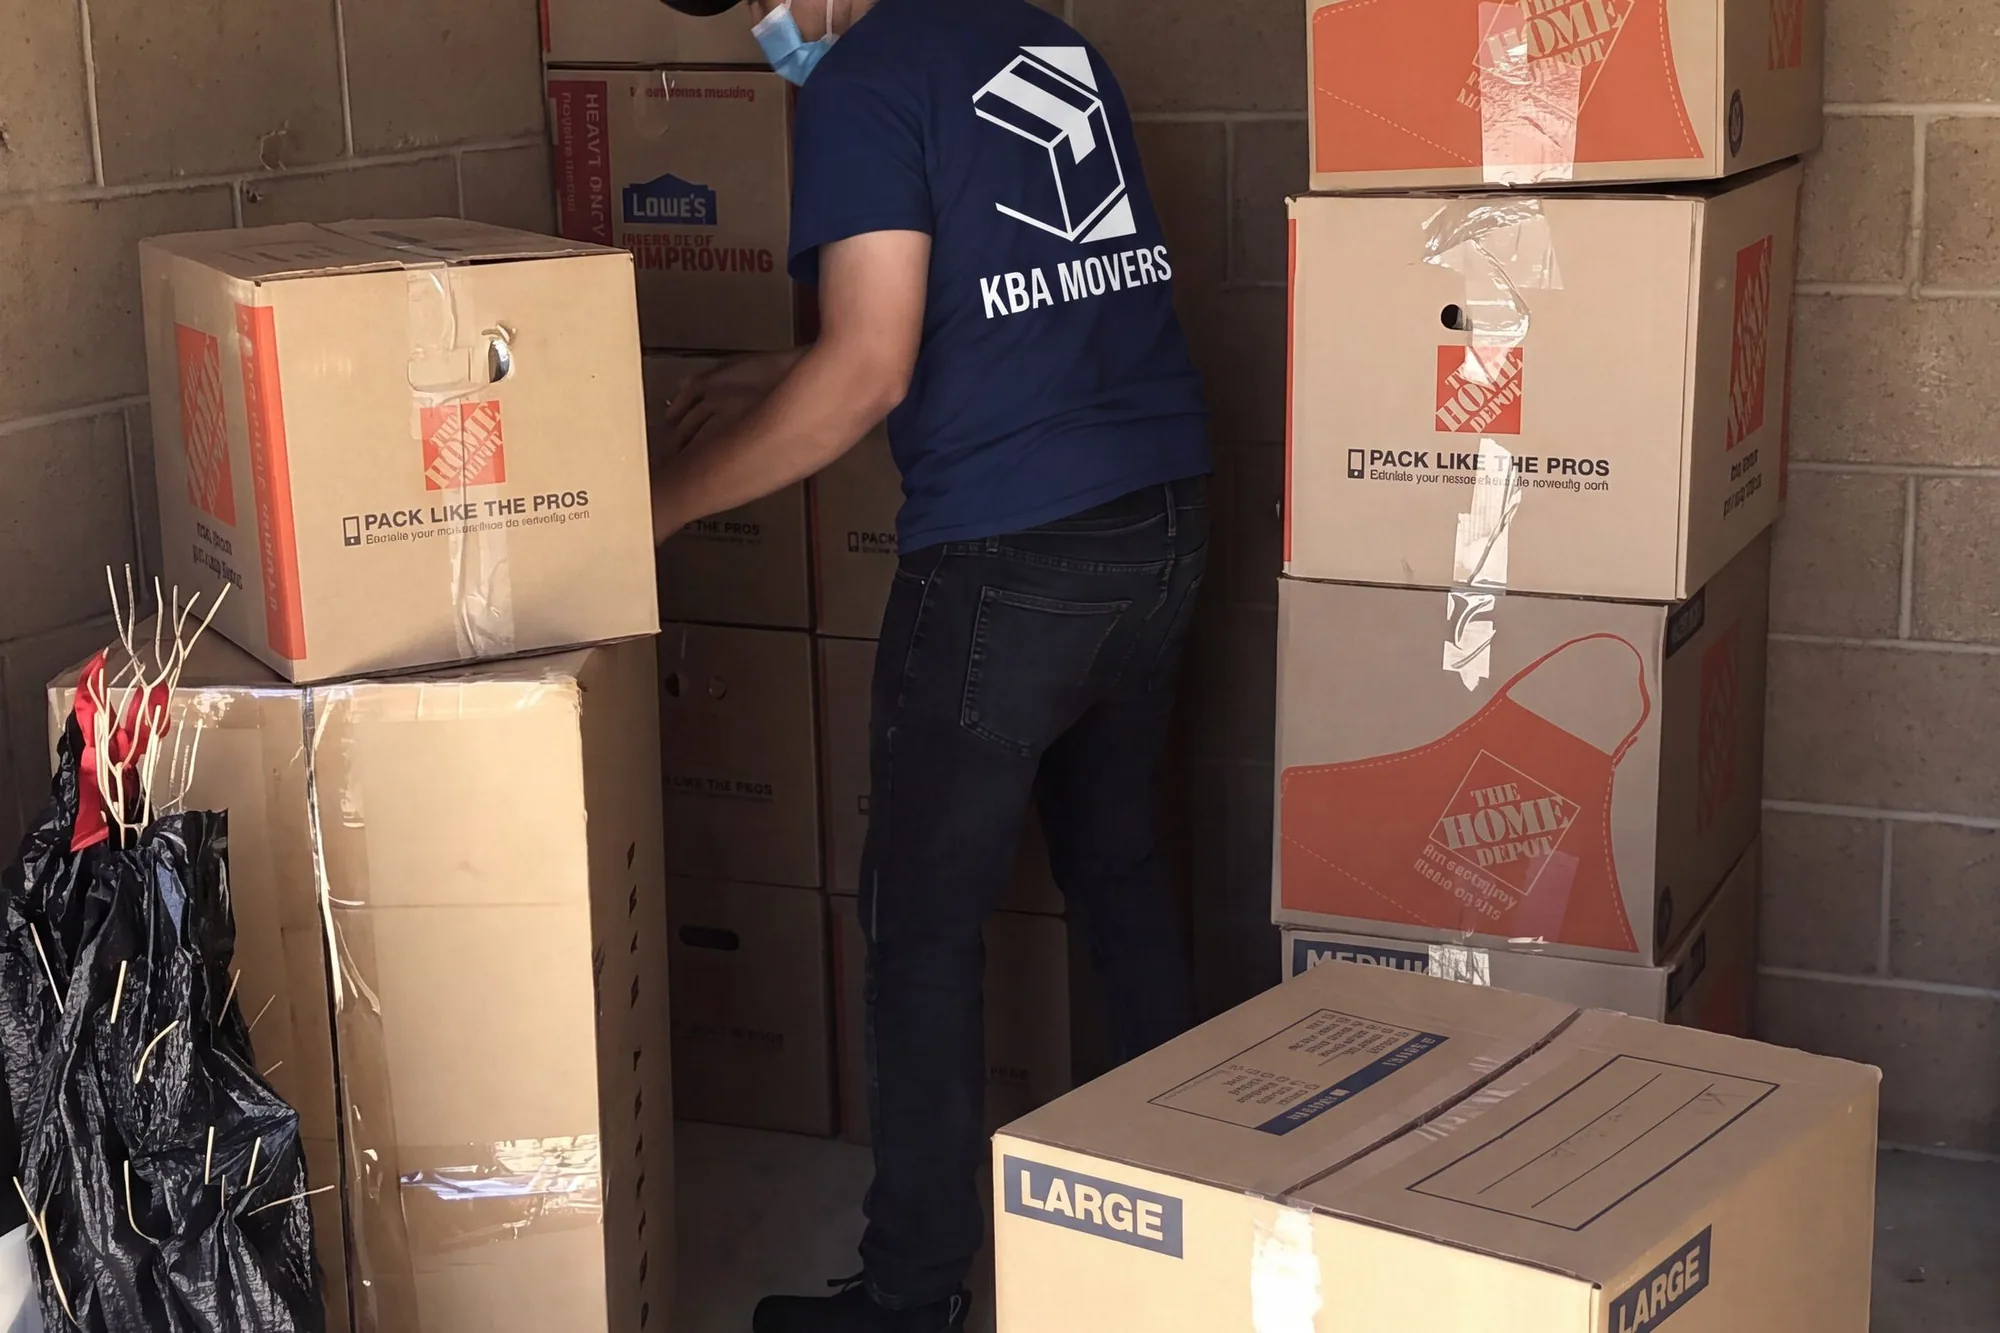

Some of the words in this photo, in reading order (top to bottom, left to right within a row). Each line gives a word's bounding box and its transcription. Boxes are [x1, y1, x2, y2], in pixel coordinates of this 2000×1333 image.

[1487, 0, 1624, 70] HOME
[632, 193, 707, 218] LOWE'S
[636, 248, 774, 273] IMPROVING
[980, 267, 1054, 319] KBA
[1057, 244, 1172, 302] MOVERS
[1469, 379, 1522, 433] DEPOT
[1370, 449, 1429, 468] PACK
[1436, 452, 1486, 470] LIKE
[1494, 454, 1539, 474] THE
[1546, 457, 1610, 476] PROS
[1416, 474, 1440, 485] your
[364, 508, 424, 531] PACK
[430, 503, 478, 523] LIKE
[484, 497, 526, 517] THE
[533, 490, 589, 512] PROS
[411, 529, 435, 542] your
[696, 520, 720, 534] THE
[724, 521, 761, 535] PROS
[861, 531, 898, 545] PACK
[707, 779, 732, 791] THE
[1470, 783, 1521, 808] THE
[1440, 796, 1570, 850] HOME
[1476, 835, 1553, 868] DEPOT
[1307, 949, 1430, 975] MDIU
[1020, 1169, 1164, 1242] LARGE
[1619, 1245, 1700, 1333] LARGE
